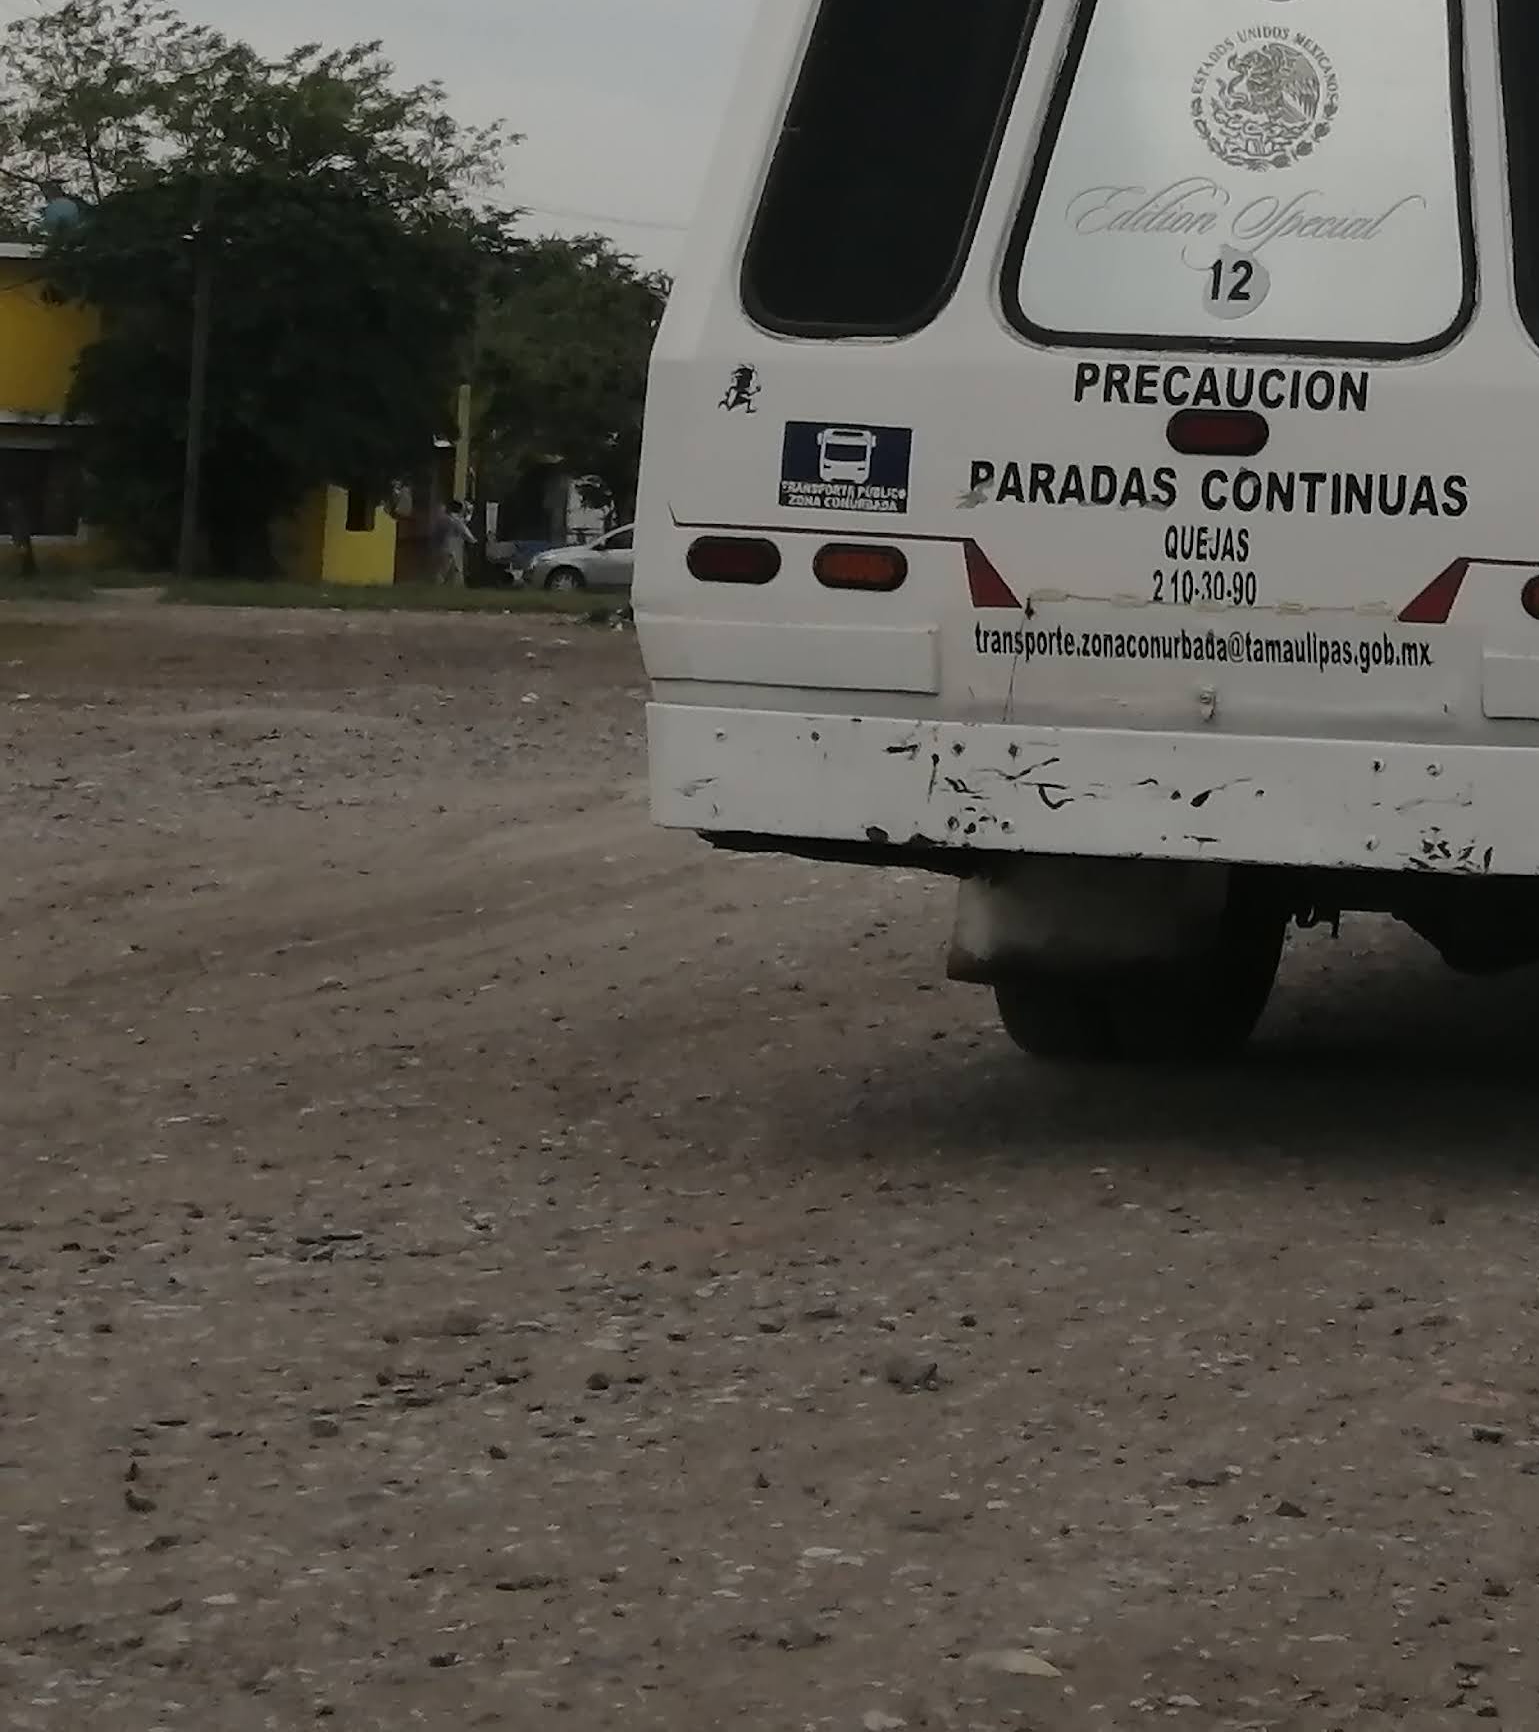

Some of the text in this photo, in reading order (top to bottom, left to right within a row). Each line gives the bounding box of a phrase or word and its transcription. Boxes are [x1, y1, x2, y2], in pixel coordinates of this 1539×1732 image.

[1191, 26, 1339, 101] ESTADOS UNIDOS MEXICANOS
[1210, 259, 1254, 301] 12
[1073, 362, 1369, 412] PRECAUCION
[788, 493, 822, 508] ZONA
[968, 460, 1469, 518] PARADAS CONTINUAS
[1165, 525, 1249, 562] QUEJAS
